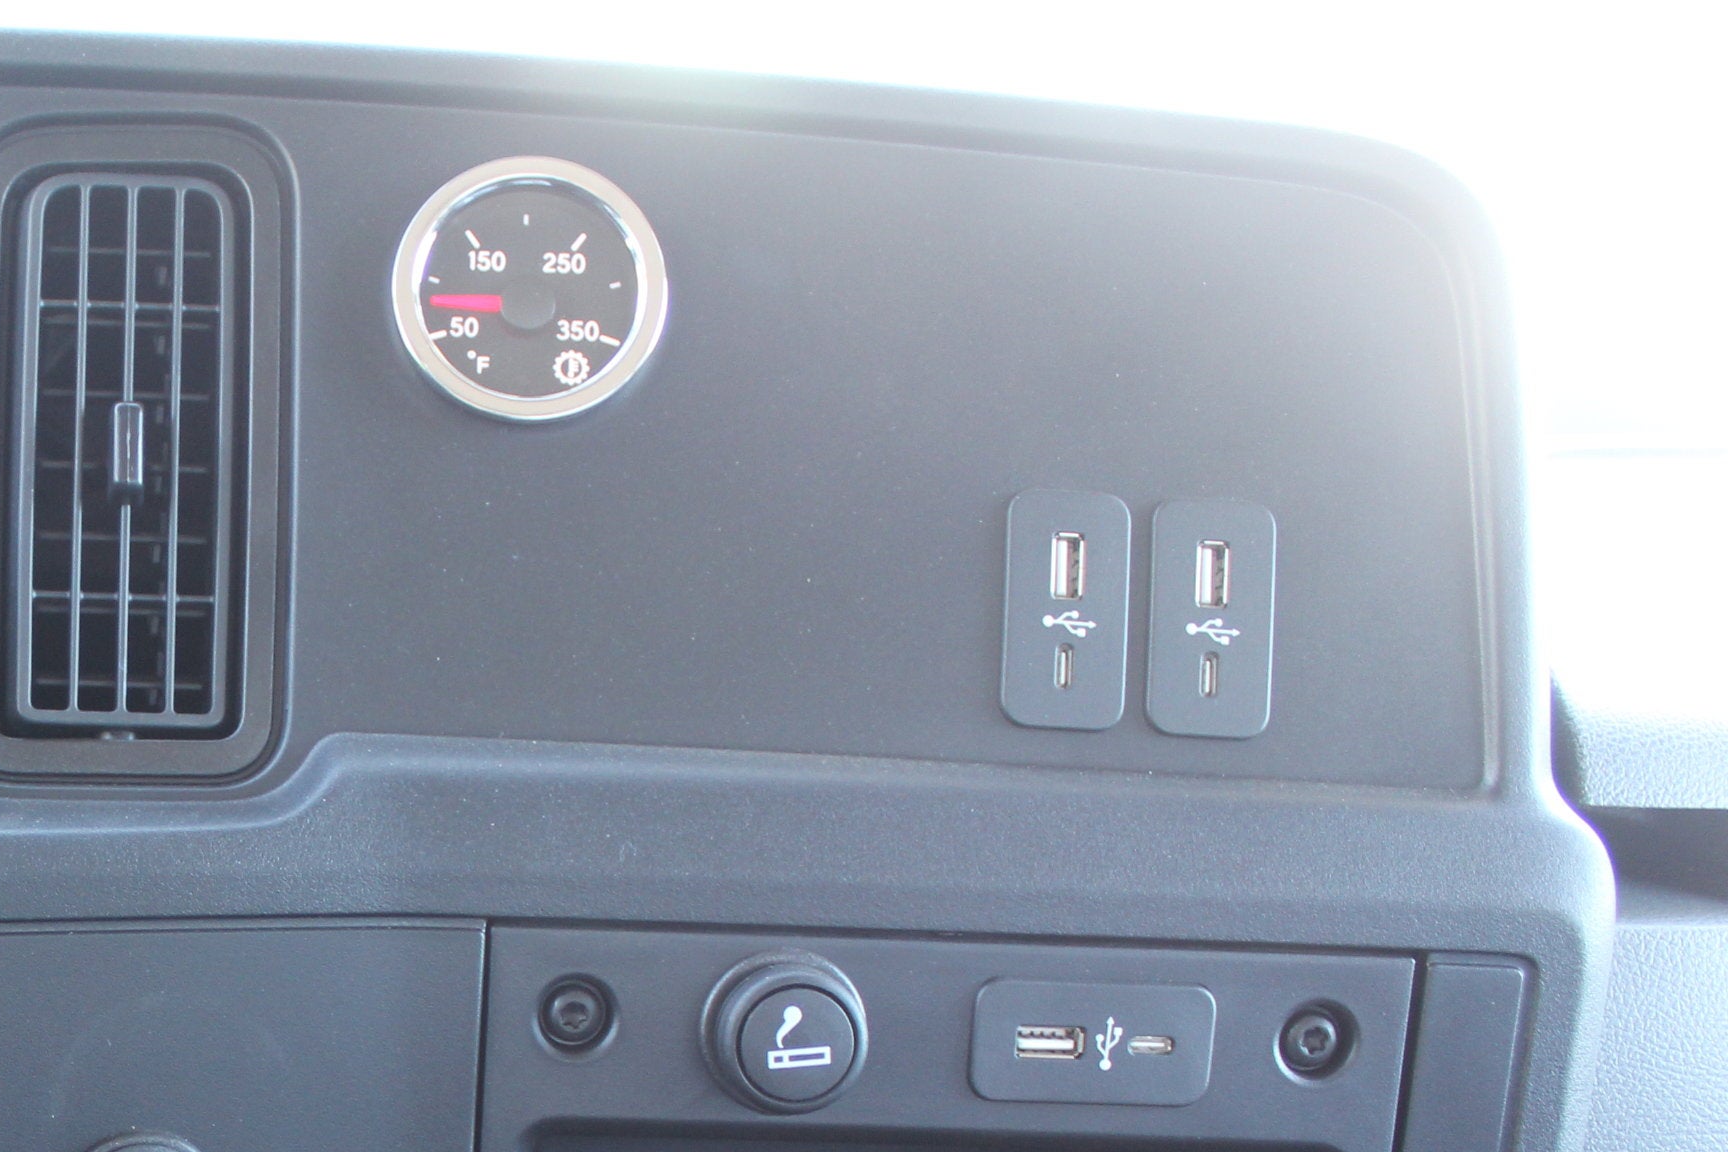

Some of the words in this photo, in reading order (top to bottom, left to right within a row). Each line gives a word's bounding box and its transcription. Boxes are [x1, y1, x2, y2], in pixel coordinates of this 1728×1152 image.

[467, 250, 507, 272] 150
[542, 253, 587, 275] 250
[449, 316, 479, 338] 50
[556, 320, 600, 342] 350
